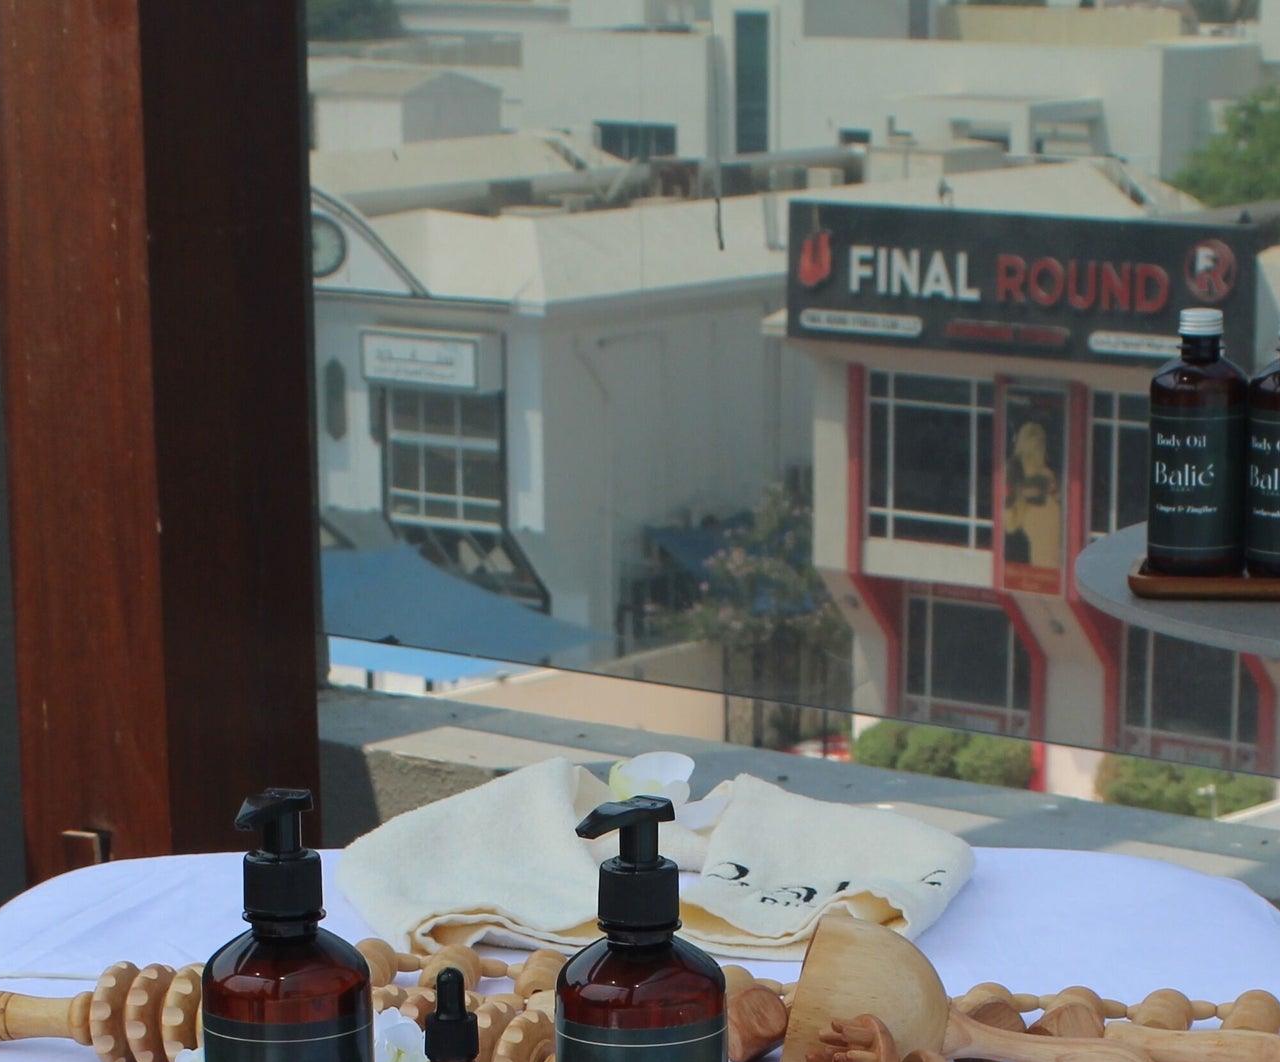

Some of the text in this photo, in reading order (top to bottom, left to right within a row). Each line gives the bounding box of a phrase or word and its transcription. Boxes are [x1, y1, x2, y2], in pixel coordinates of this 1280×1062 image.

[849, 245, 1170, 313] FINAL ROUND
[1157, 433, 1206, 451] Body Oil
[1251, 436, 1272, 455] Body
